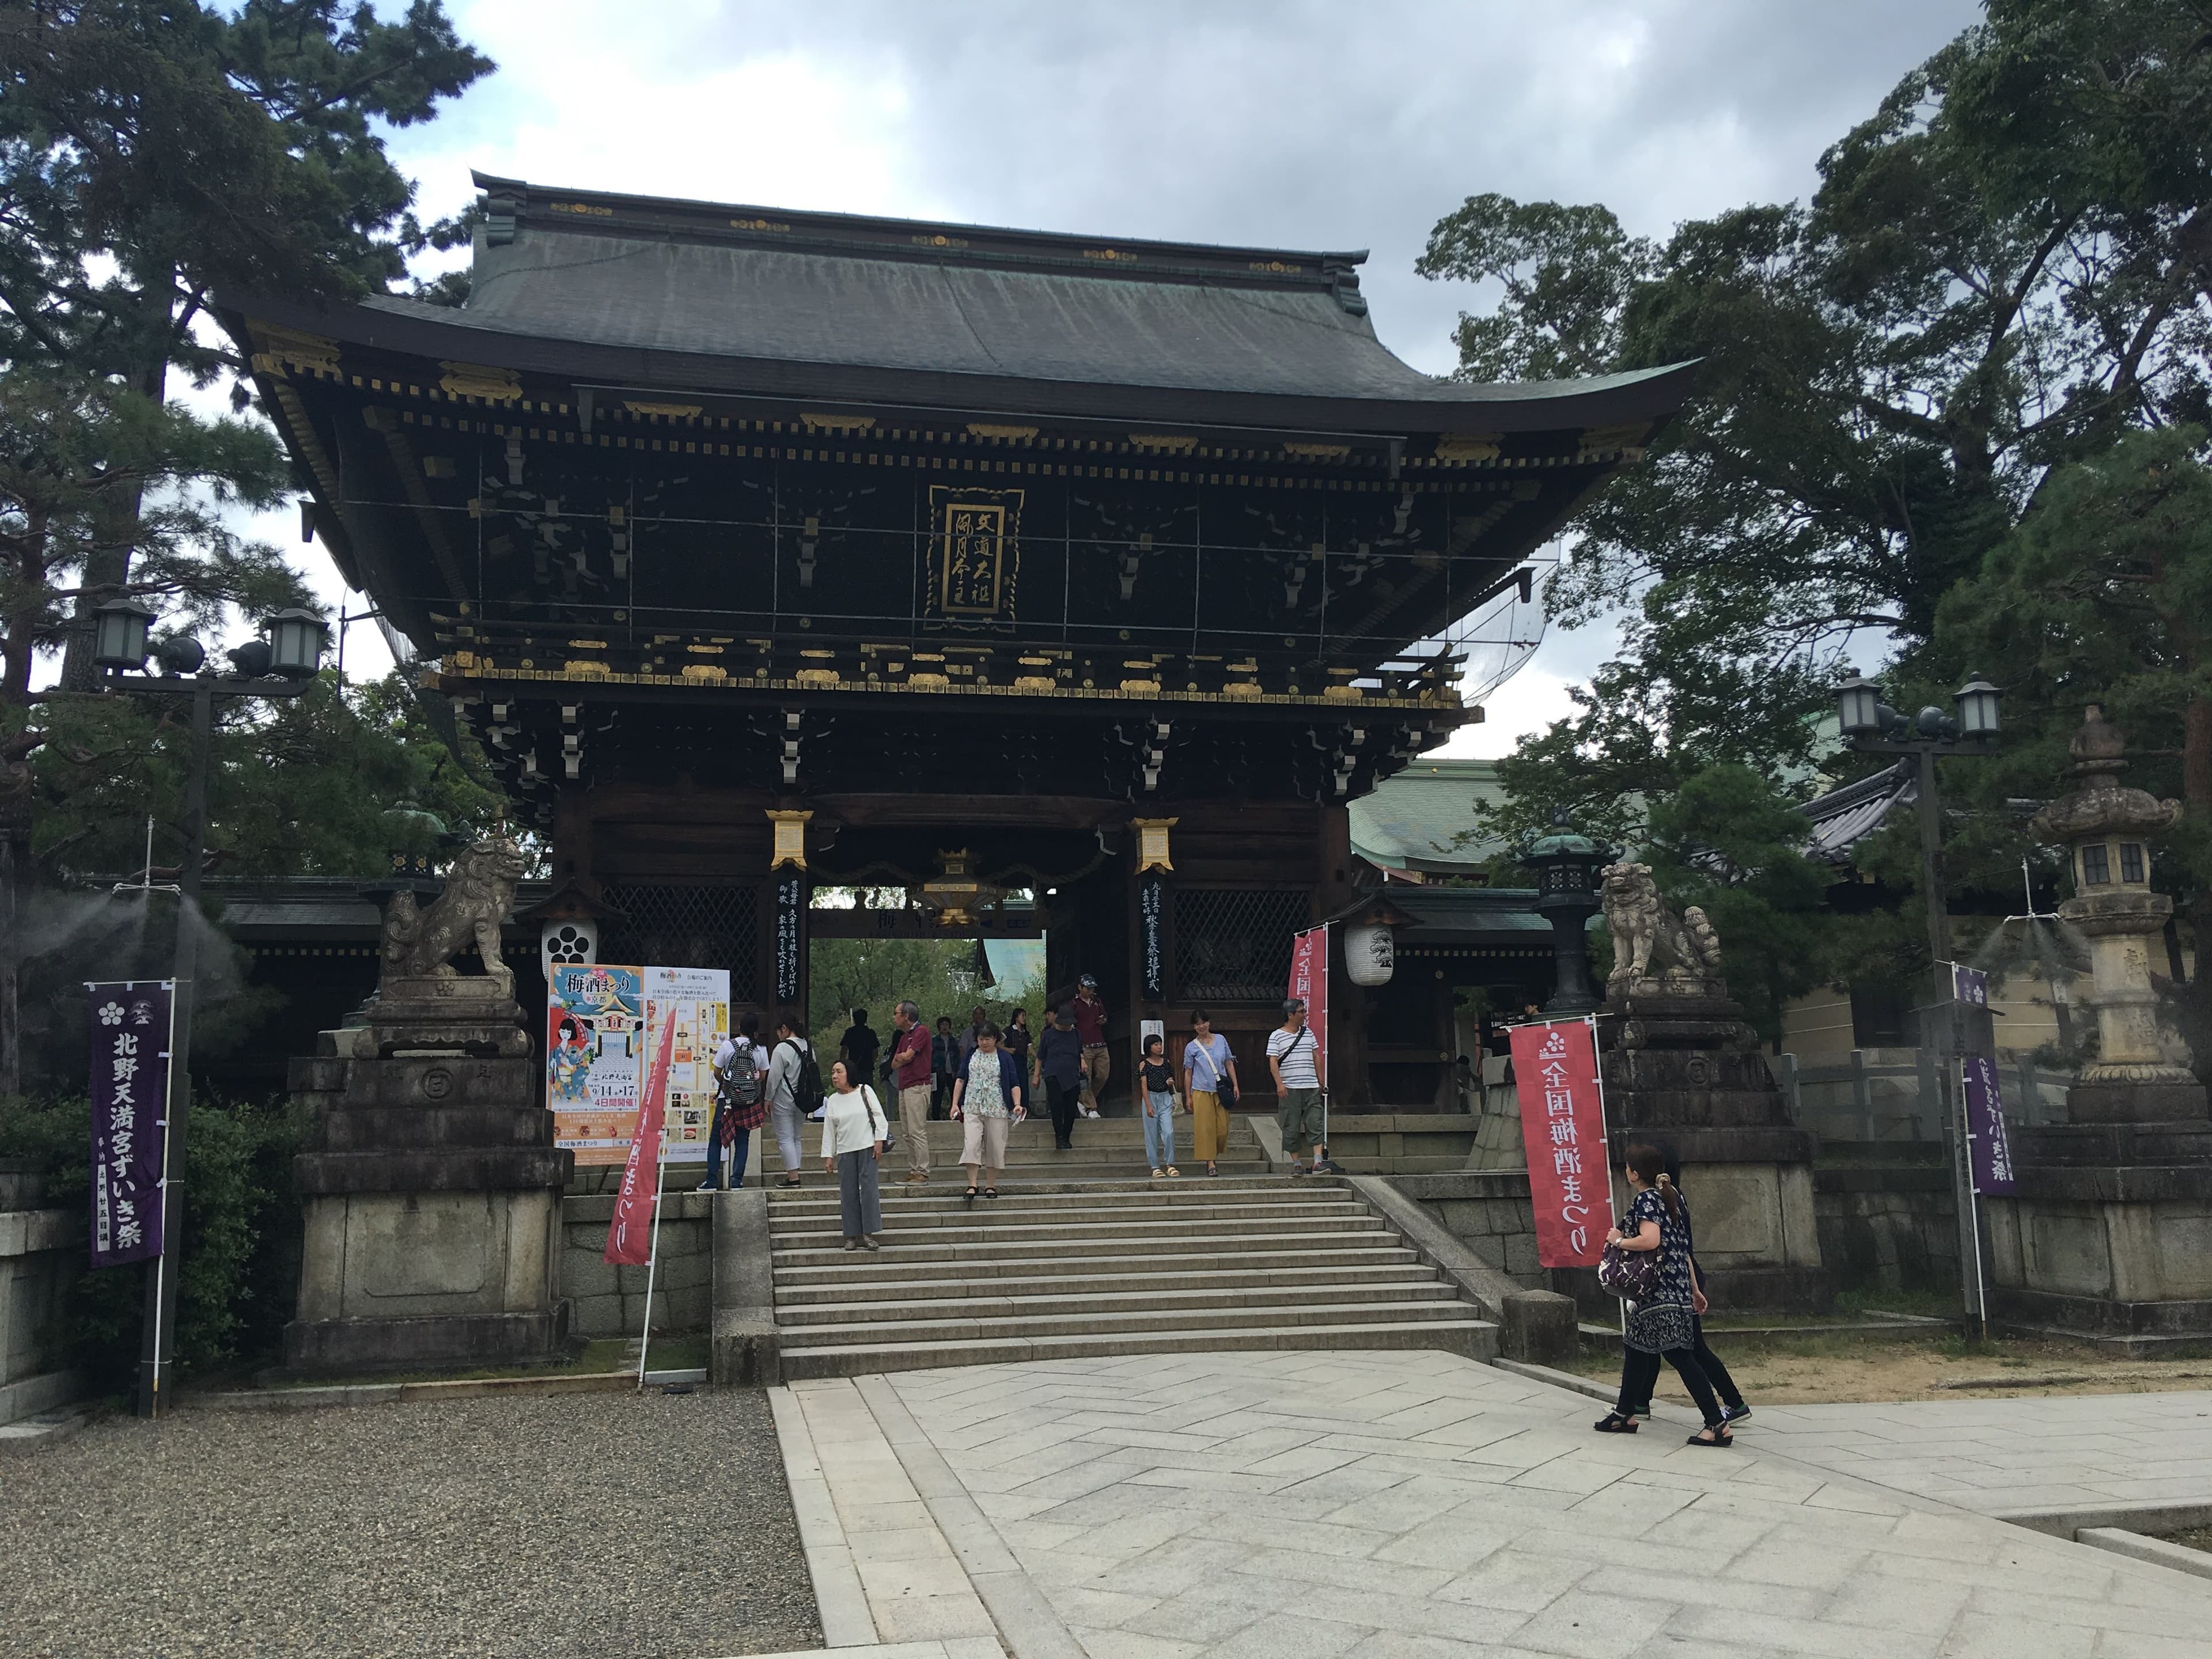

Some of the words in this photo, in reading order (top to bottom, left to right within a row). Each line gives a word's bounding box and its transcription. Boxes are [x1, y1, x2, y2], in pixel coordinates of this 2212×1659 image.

[567, 974, 630, 993] 梅酒まつり
[595, 1099, 637, 1107] 4日間開催!
[110, 1033, 142, 1250] 北野天満宮ずいき祭
